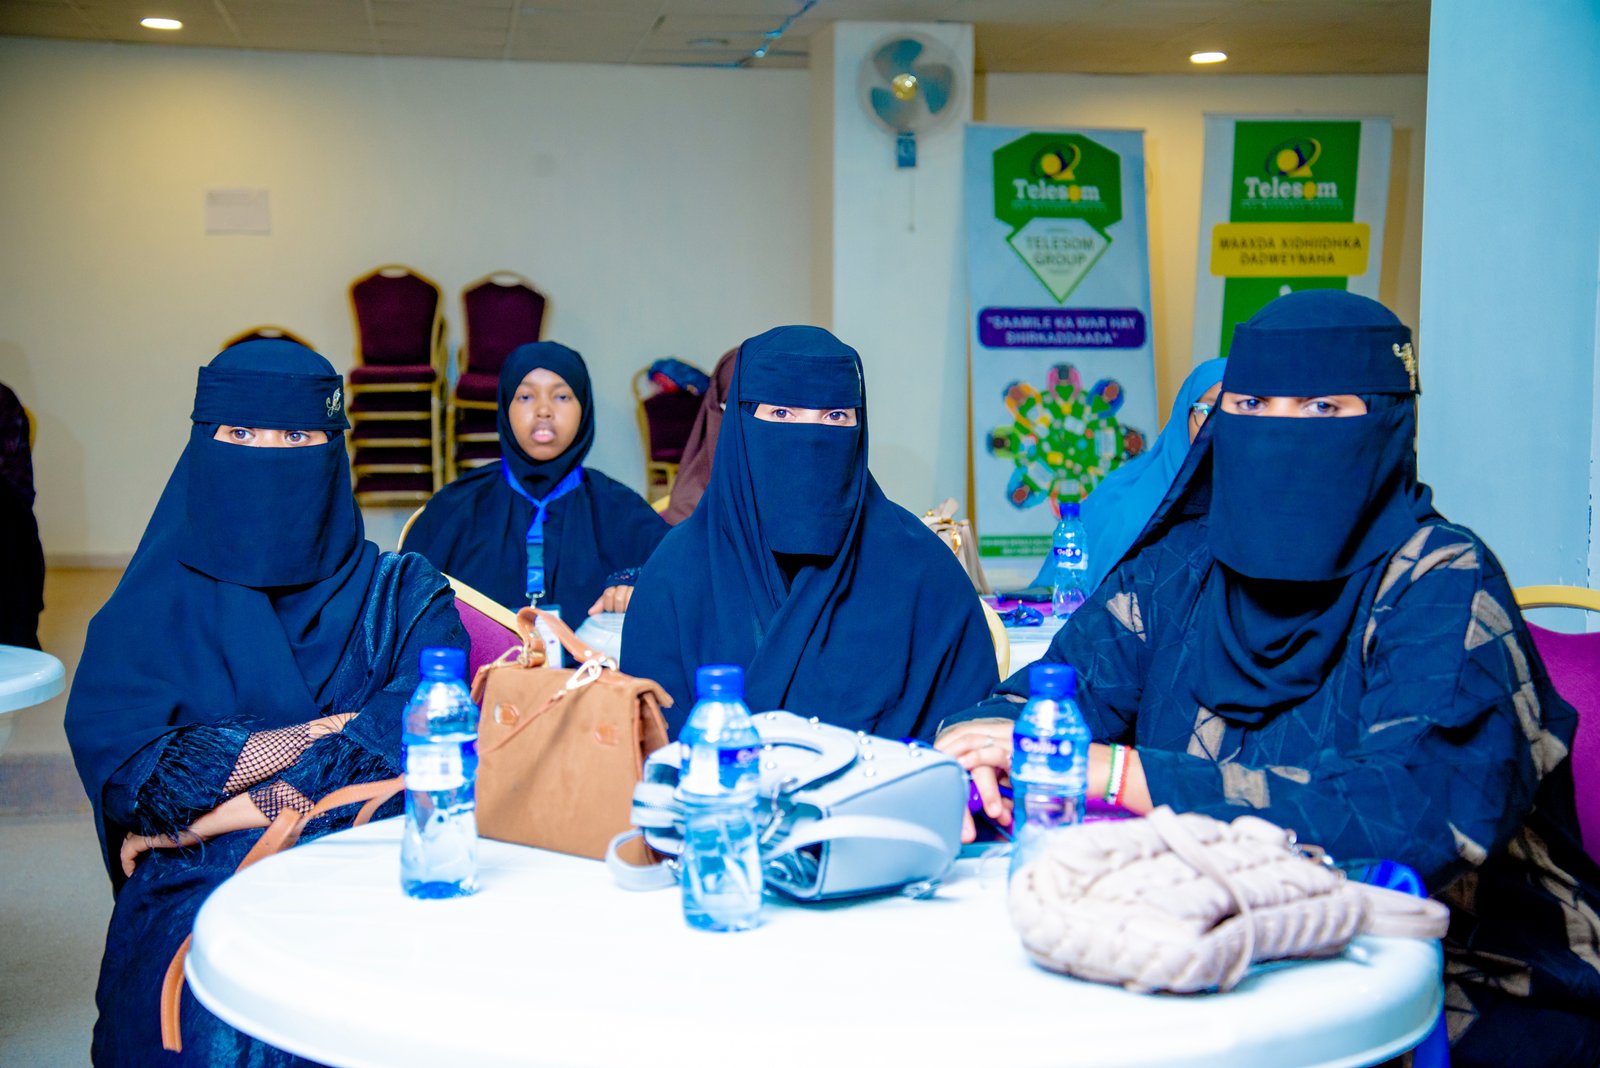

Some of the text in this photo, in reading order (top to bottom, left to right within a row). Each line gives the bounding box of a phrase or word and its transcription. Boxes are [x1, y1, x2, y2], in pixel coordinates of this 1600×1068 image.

[1012, 179, 1101, 203] Telesom
[1244, 177, 1338, 200] Telesom
[1025, 236, 1095, 250] TELESOM
[1033, 252, 1087, 266] GROUP
